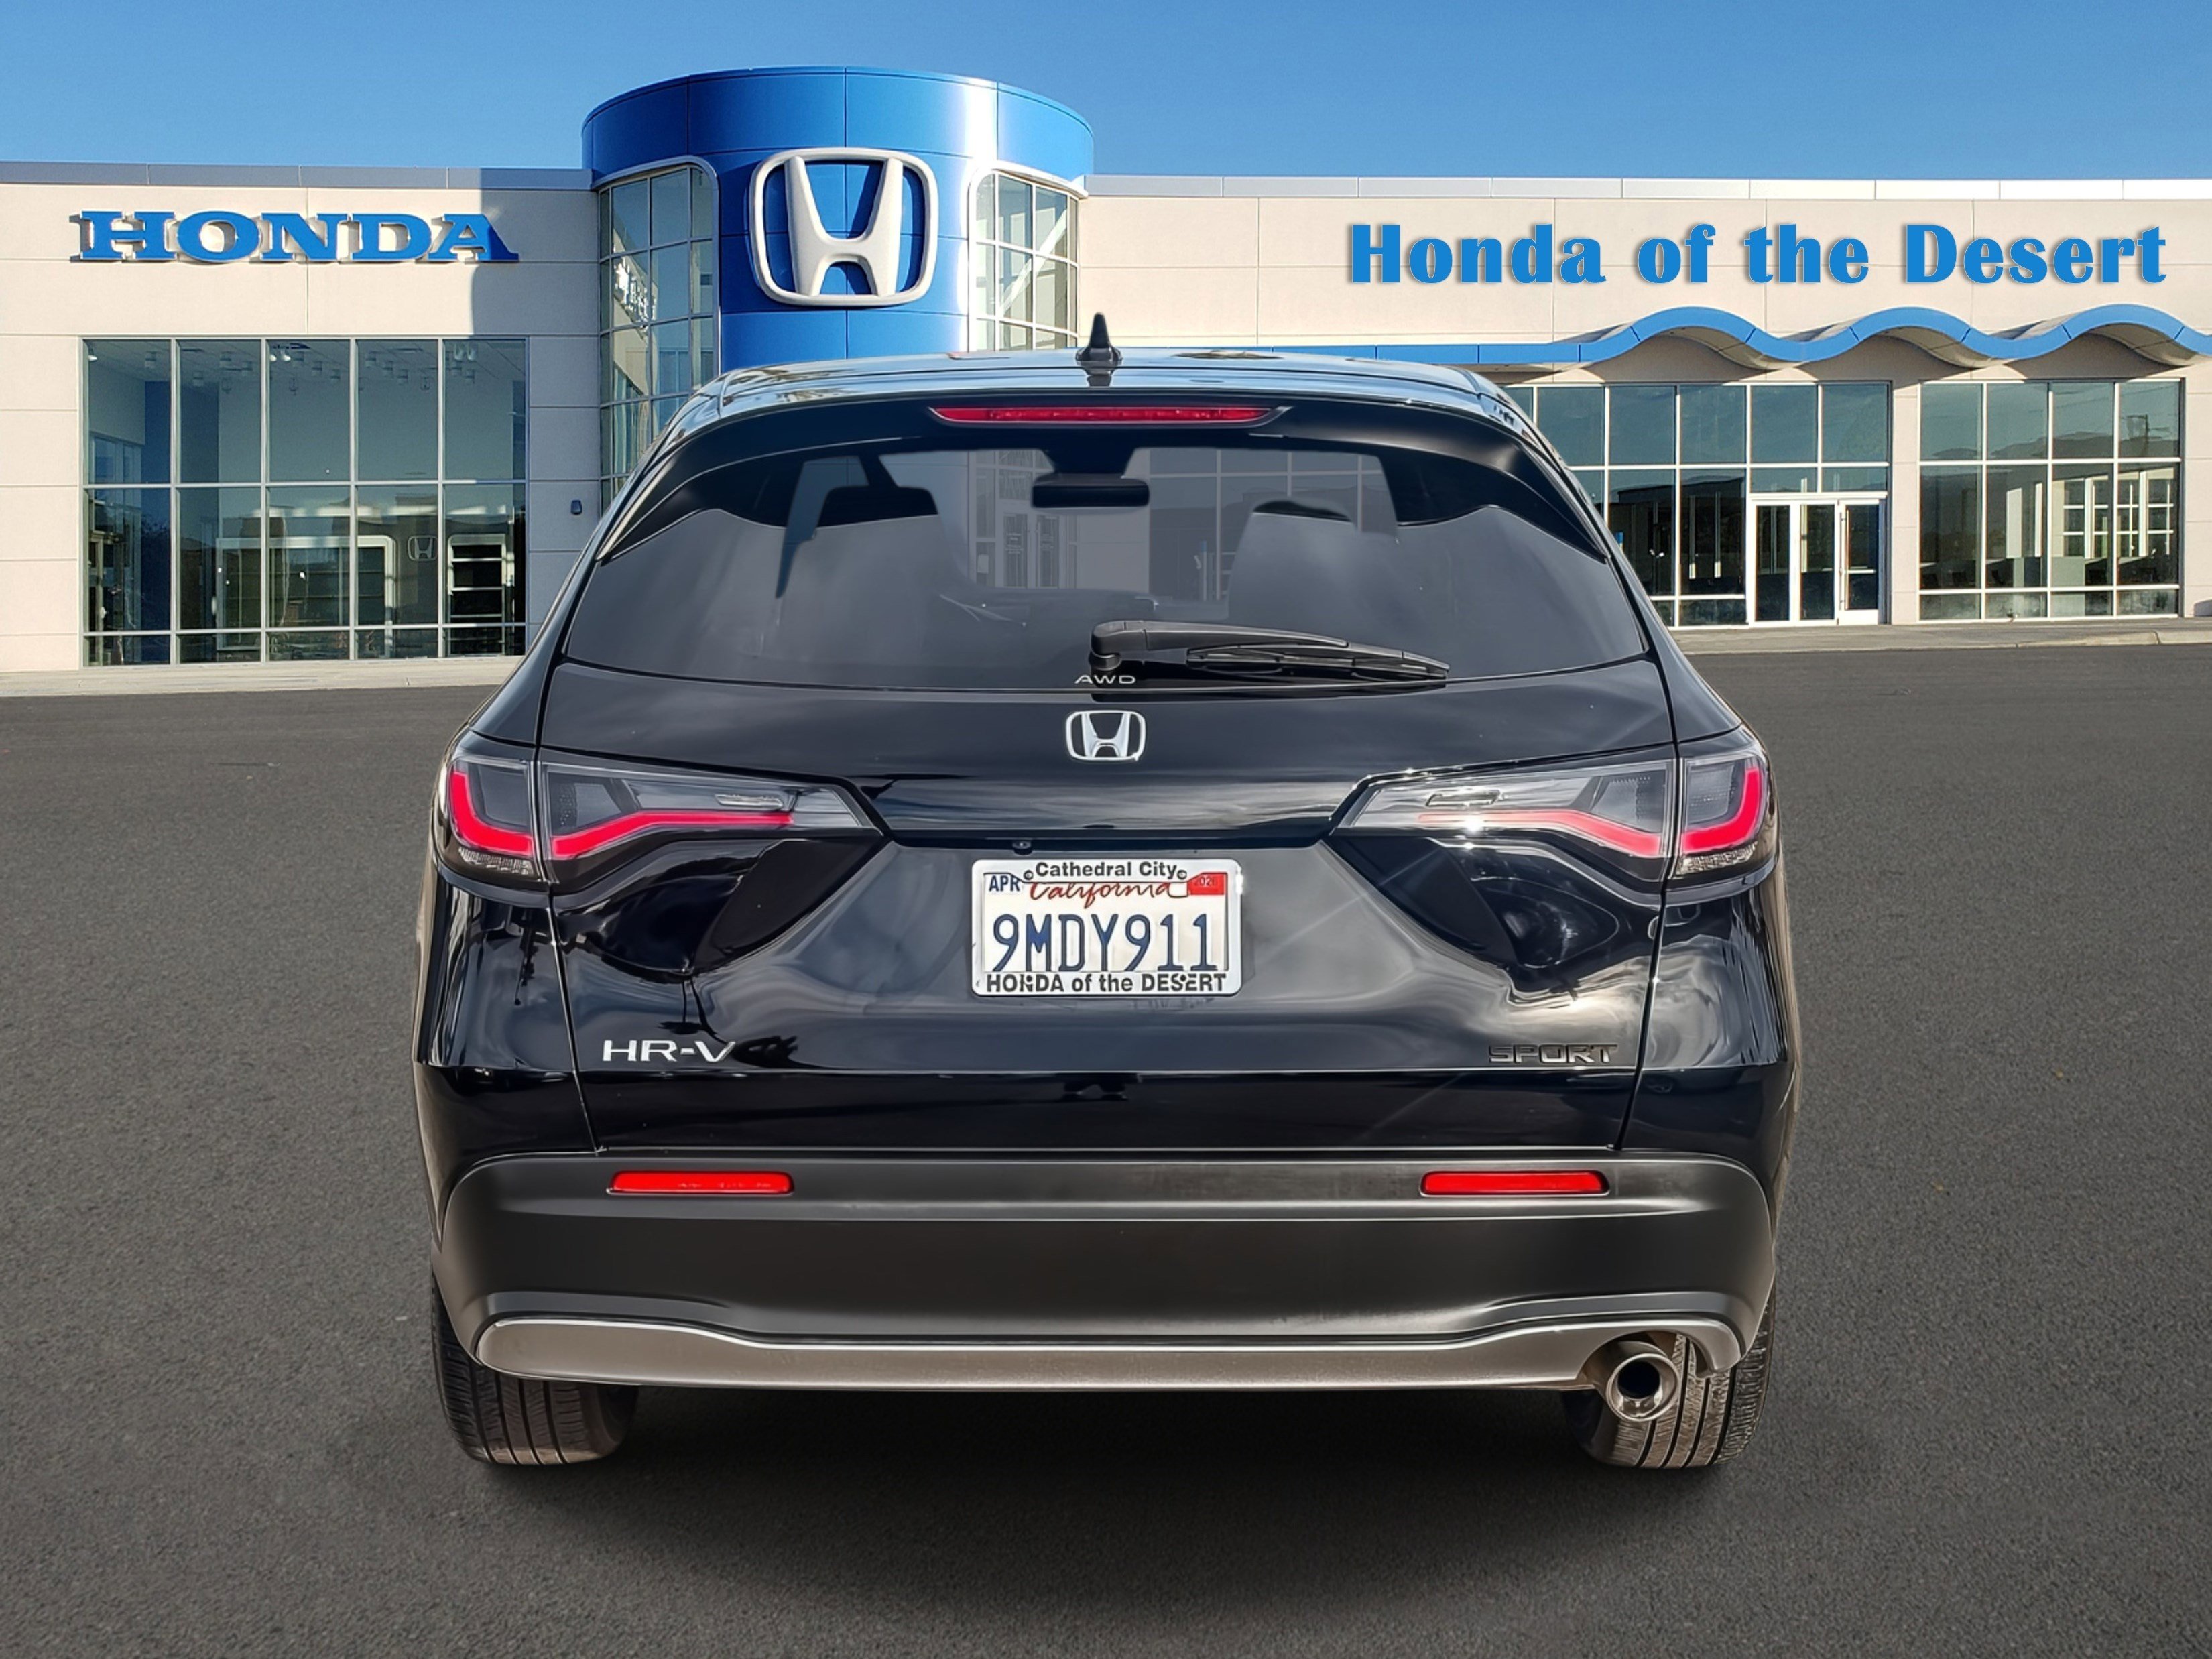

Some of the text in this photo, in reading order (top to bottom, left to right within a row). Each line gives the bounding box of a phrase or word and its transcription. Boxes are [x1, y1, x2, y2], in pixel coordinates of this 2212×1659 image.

[78, 210, 520, 263] HONDA
[1351, 223, 2168, 284] Honda of the Desert
[1074, 674, 1136, 684] AWD
[1035, 861, 1178, 880] Cathedral City
[988, 874, 1021, 892] APR
[1029, 881, 1174, 910] California
[992, 913, 1218, 972] 9MDY911
[985, 973, 1227, 993] HONDA of the DESERT
[602, 1040, 737, 1063] HR-V
[1488, 1044, 1618, 1064] SPORT
